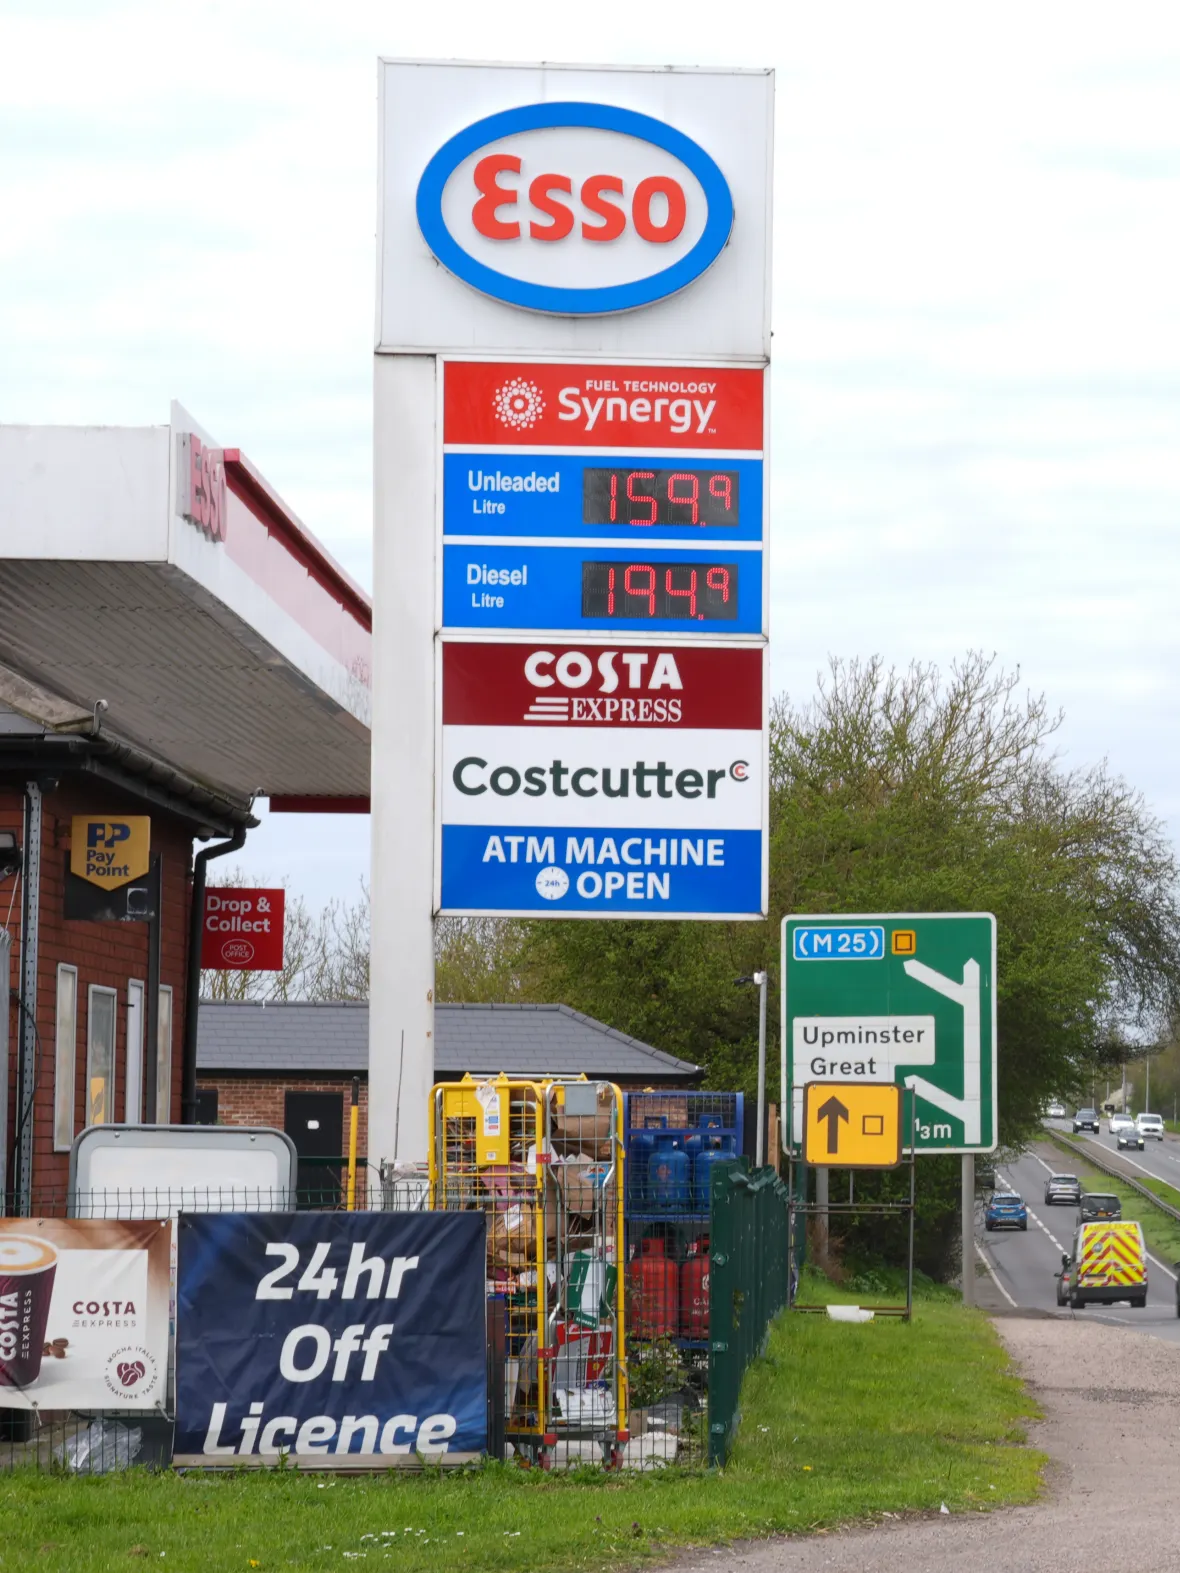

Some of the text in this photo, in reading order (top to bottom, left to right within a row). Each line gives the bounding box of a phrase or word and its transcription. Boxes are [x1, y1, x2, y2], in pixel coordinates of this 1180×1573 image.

[471, 153, 687, 243] Esso
[585, 379, 717, 394] FUEL TECHNOLOGY
[558, 386, 717, 434] Synergy
[468, 470, 560, 492] Unleaded
[473, 499, 506, 514] Litre
[466, 563, 528, 585] Diesel
[471, 593, 505, 608] Litre
[524, 650, 683, 694] COSTA
[570, 697, 682, 723] EXPRESS
[452, 756, 726, 799] Costcutter
[86, 849, 115, 866] Pay
[482, 835, 725, 867] ATM MACHINE
[86, 863, 130, 877] Point
[576, 870, 670, 900] OPEN
[206, 895, 271, 916] Drop &
[206, 915, 271, 933] Collect
[225, 950, 250, 958] OFFICE
[802, 1024, 926, 1048] Upminster
[809, 1056, 877, 1076] Great
[255, 1241, 419, 1300] 24hr
[22, 1289, 32, 1349] EXPRESS
[72, 1301, 137, 1317] COSTA
[0, 1291, 20, 1361] COSTA
[81, 1319, 137, 1328] EXPRESS
[107, 1345, 156, 1364] MOCHA ITALIA
[279, 1323, 394, 1383] Off
[104, 1375, 158, 1399] SIGNATURE TASTE
[202, 1401, 457, 1455] Licence
